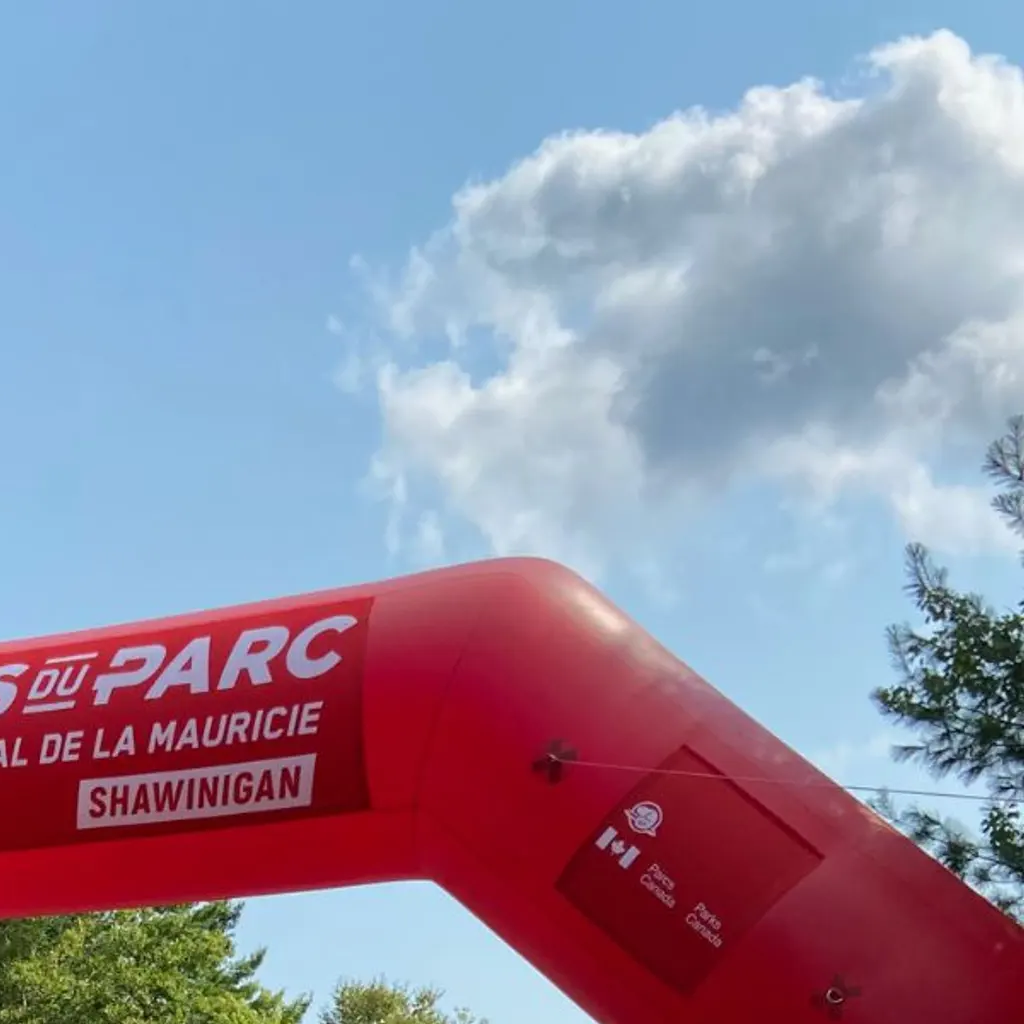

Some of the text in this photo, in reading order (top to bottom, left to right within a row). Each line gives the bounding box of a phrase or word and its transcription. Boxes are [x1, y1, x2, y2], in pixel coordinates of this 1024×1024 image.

[29, 664, 90, 699] DU
[92, 615, 358, 706] PARC
[39, 731, 83, 765] DE
[93, 725, 136, 759] LA
[148, 701, 324, 755] MAURICIE
[88, 766, 302, 819] SHAWINIGAN
[640, 873, 676, 909] Canada
[685, 912, 723, 948] Canada
